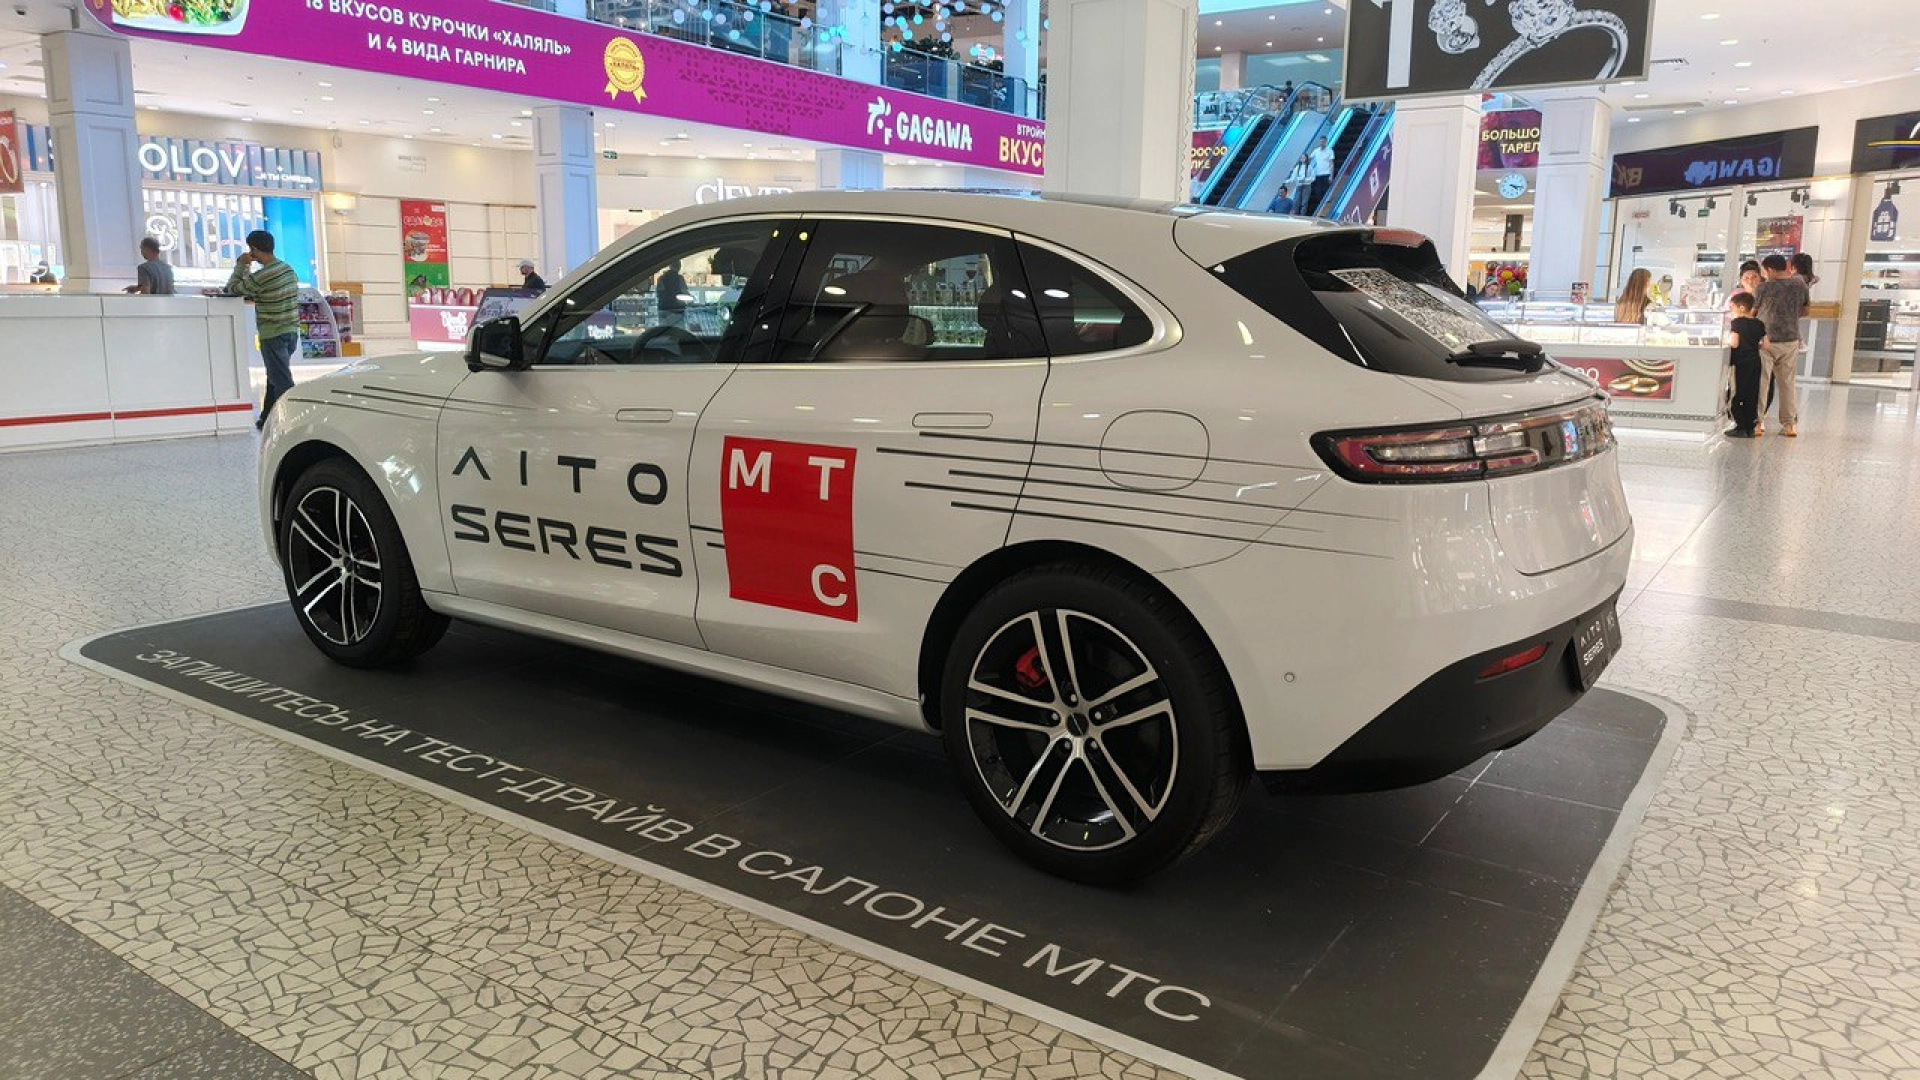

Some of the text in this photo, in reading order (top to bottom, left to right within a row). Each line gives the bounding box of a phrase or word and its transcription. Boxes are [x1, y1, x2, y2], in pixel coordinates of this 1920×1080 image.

[329, 0, 404, 25] ВКУСОВ
[409, 12, 489, 41] КУРОЧКИ
[493, 29, 571, 55] «ХАЛЯЛЬ»
[367, 33, 526, 75] И 4 ВИДА ГАРНИРА
[896, 111, 973, 151] GAGAWA
[999, 136, 1045, 168] ВКУС
[452, 446, 668, 505] AITO
[452, 504, 683, 577] SERES
[136, 650, 1212, 1021] ЗАПИШИТЕСЬ НА ТЕСТ-ДРАЙВ В САЛОНЕ МТС
